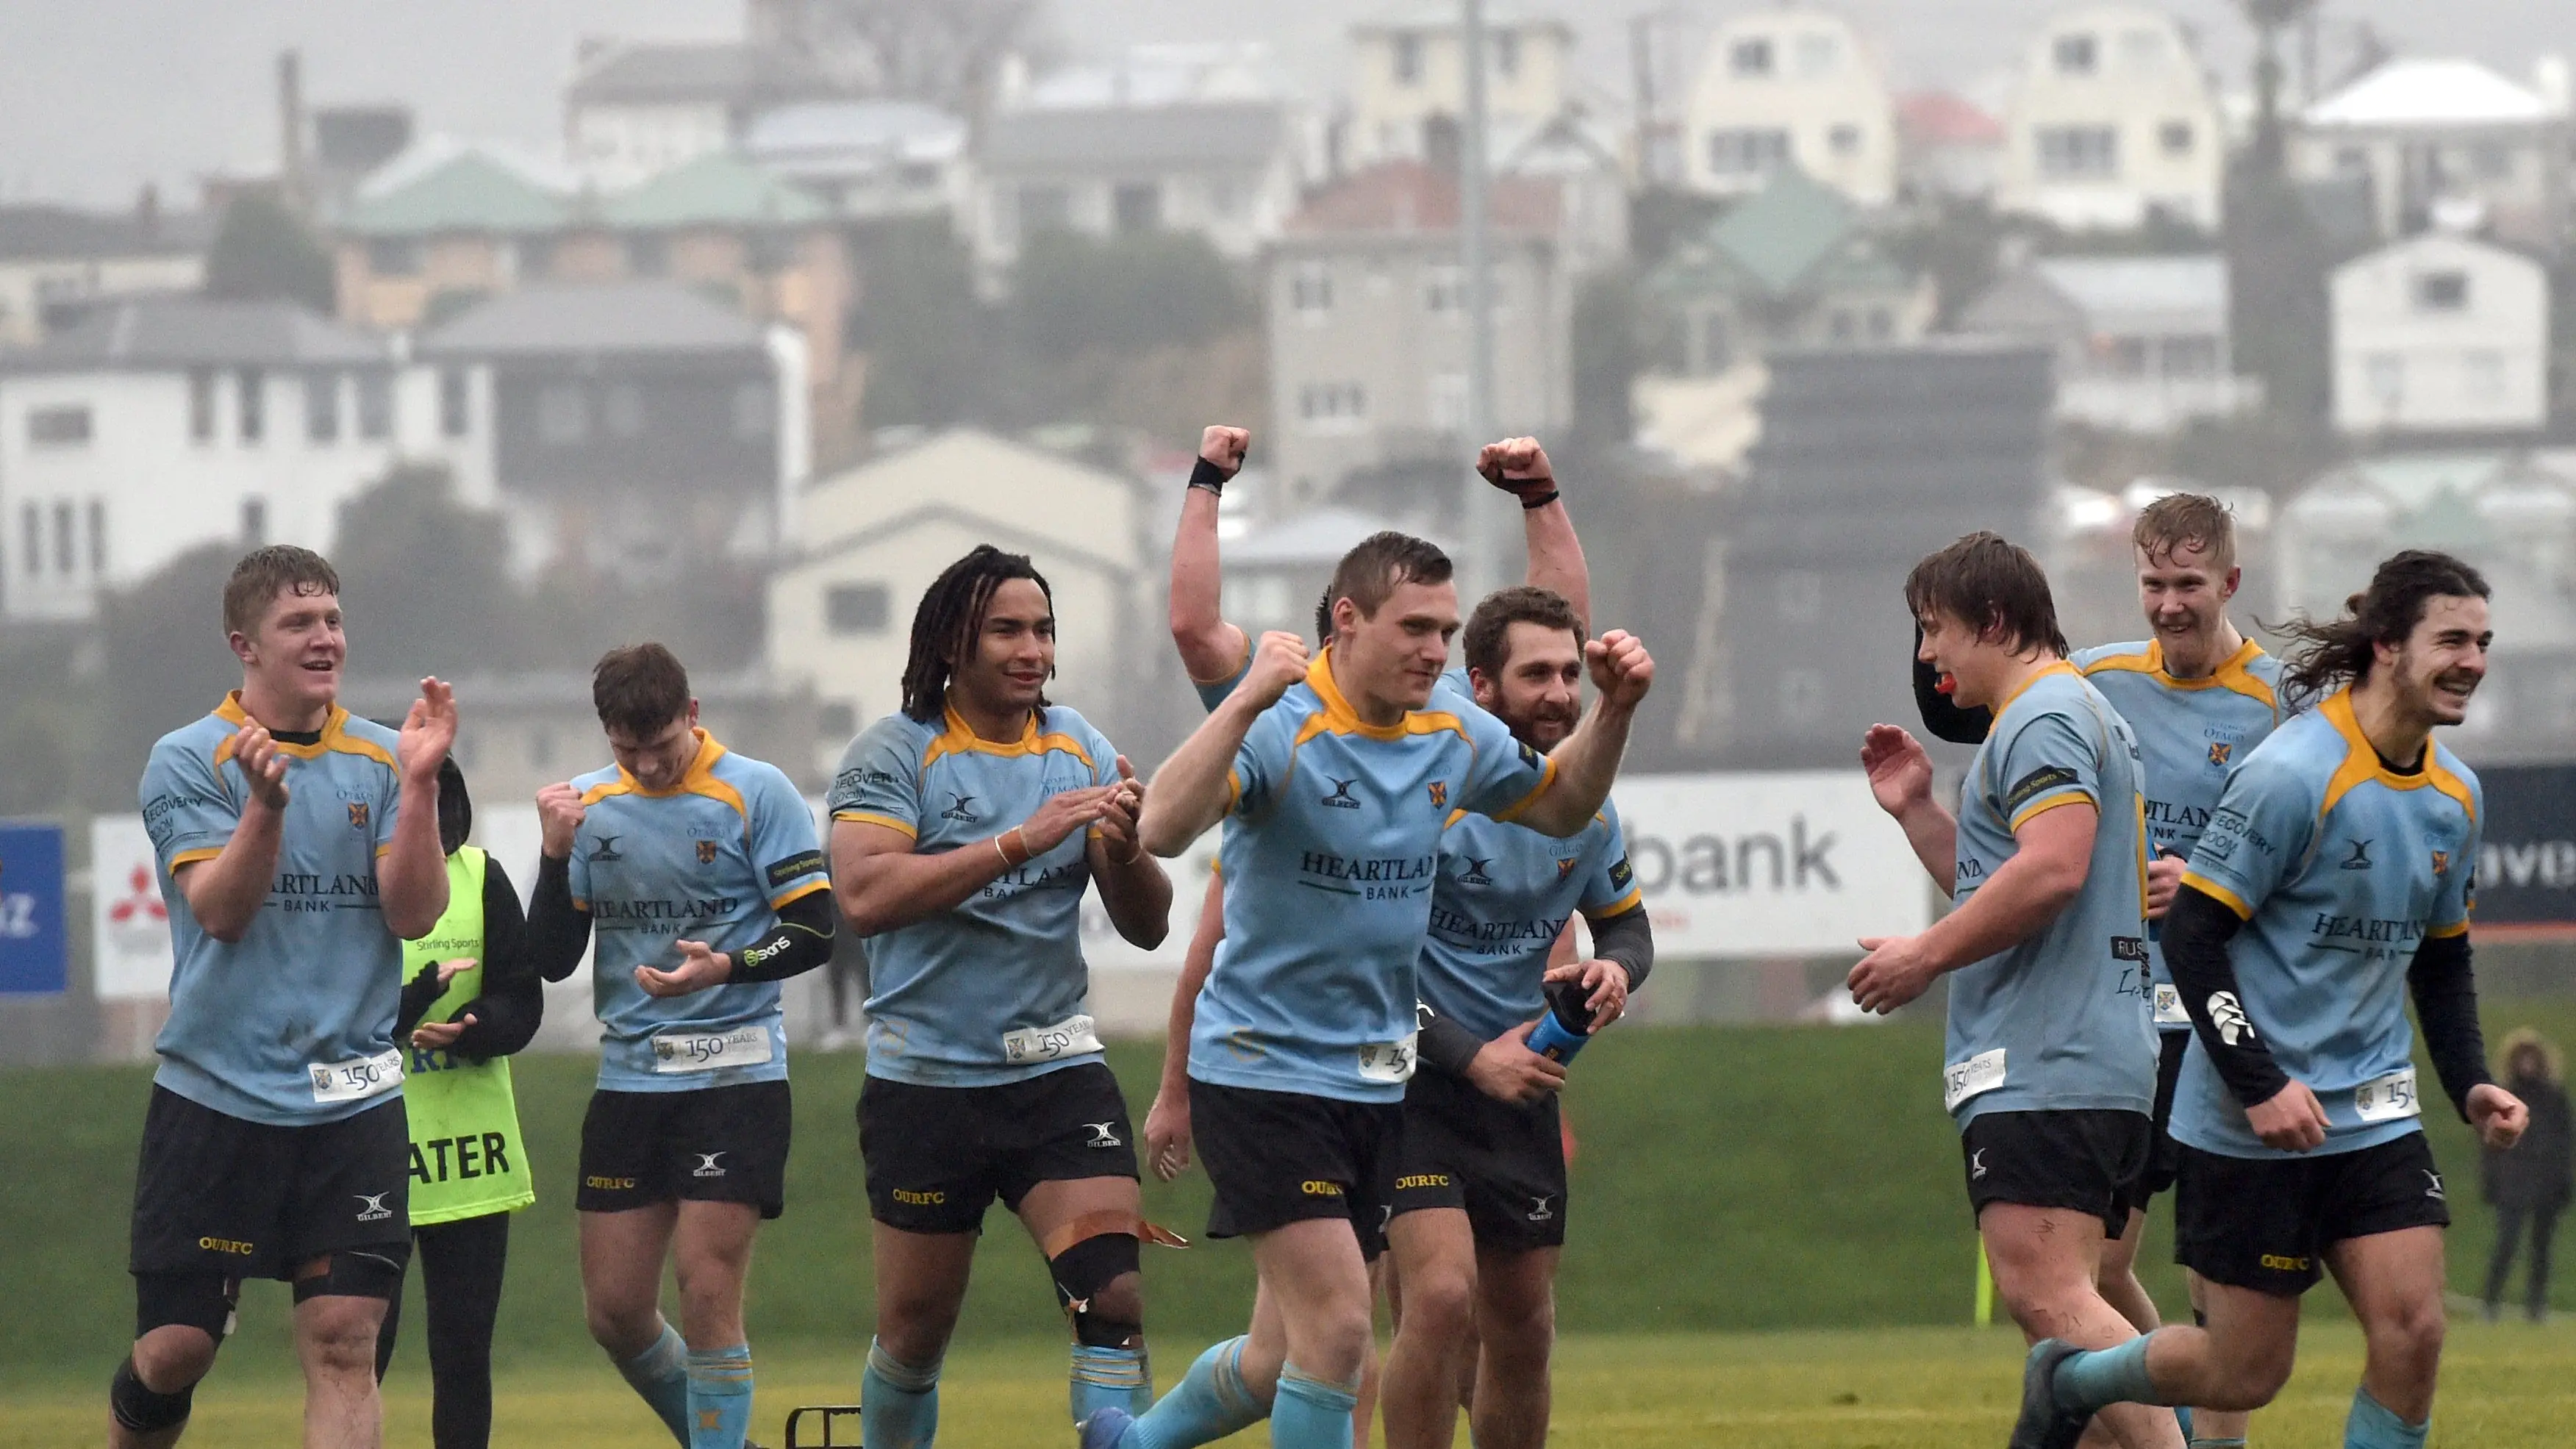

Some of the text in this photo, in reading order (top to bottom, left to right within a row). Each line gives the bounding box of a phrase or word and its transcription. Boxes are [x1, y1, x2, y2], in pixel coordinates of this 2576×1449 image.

[1365, 886, 1410, 900] BANK
[284, 899, 331, 912] BANK
[640, 923, 681, 935] BANK
[416, 938, 480, 951] Stirling Sports
[1475, 943, 1523, 956] BANK
[684, 1037, 724, 1063] 150
[725, 1031, 758, 1045] YEARS
[1037, 1031, 1070, 1058] 150
[1384, 1048, 1407, 1074] 15
[340, 1064, 379, 1091] 150
[1951, 1068, 1971, 1098] 150
[1395, 1175, 1449, 1189] OURFC
[892, 1188, 945, 1205] OURFC
[198, 1236, 254, 1256] OURFC
